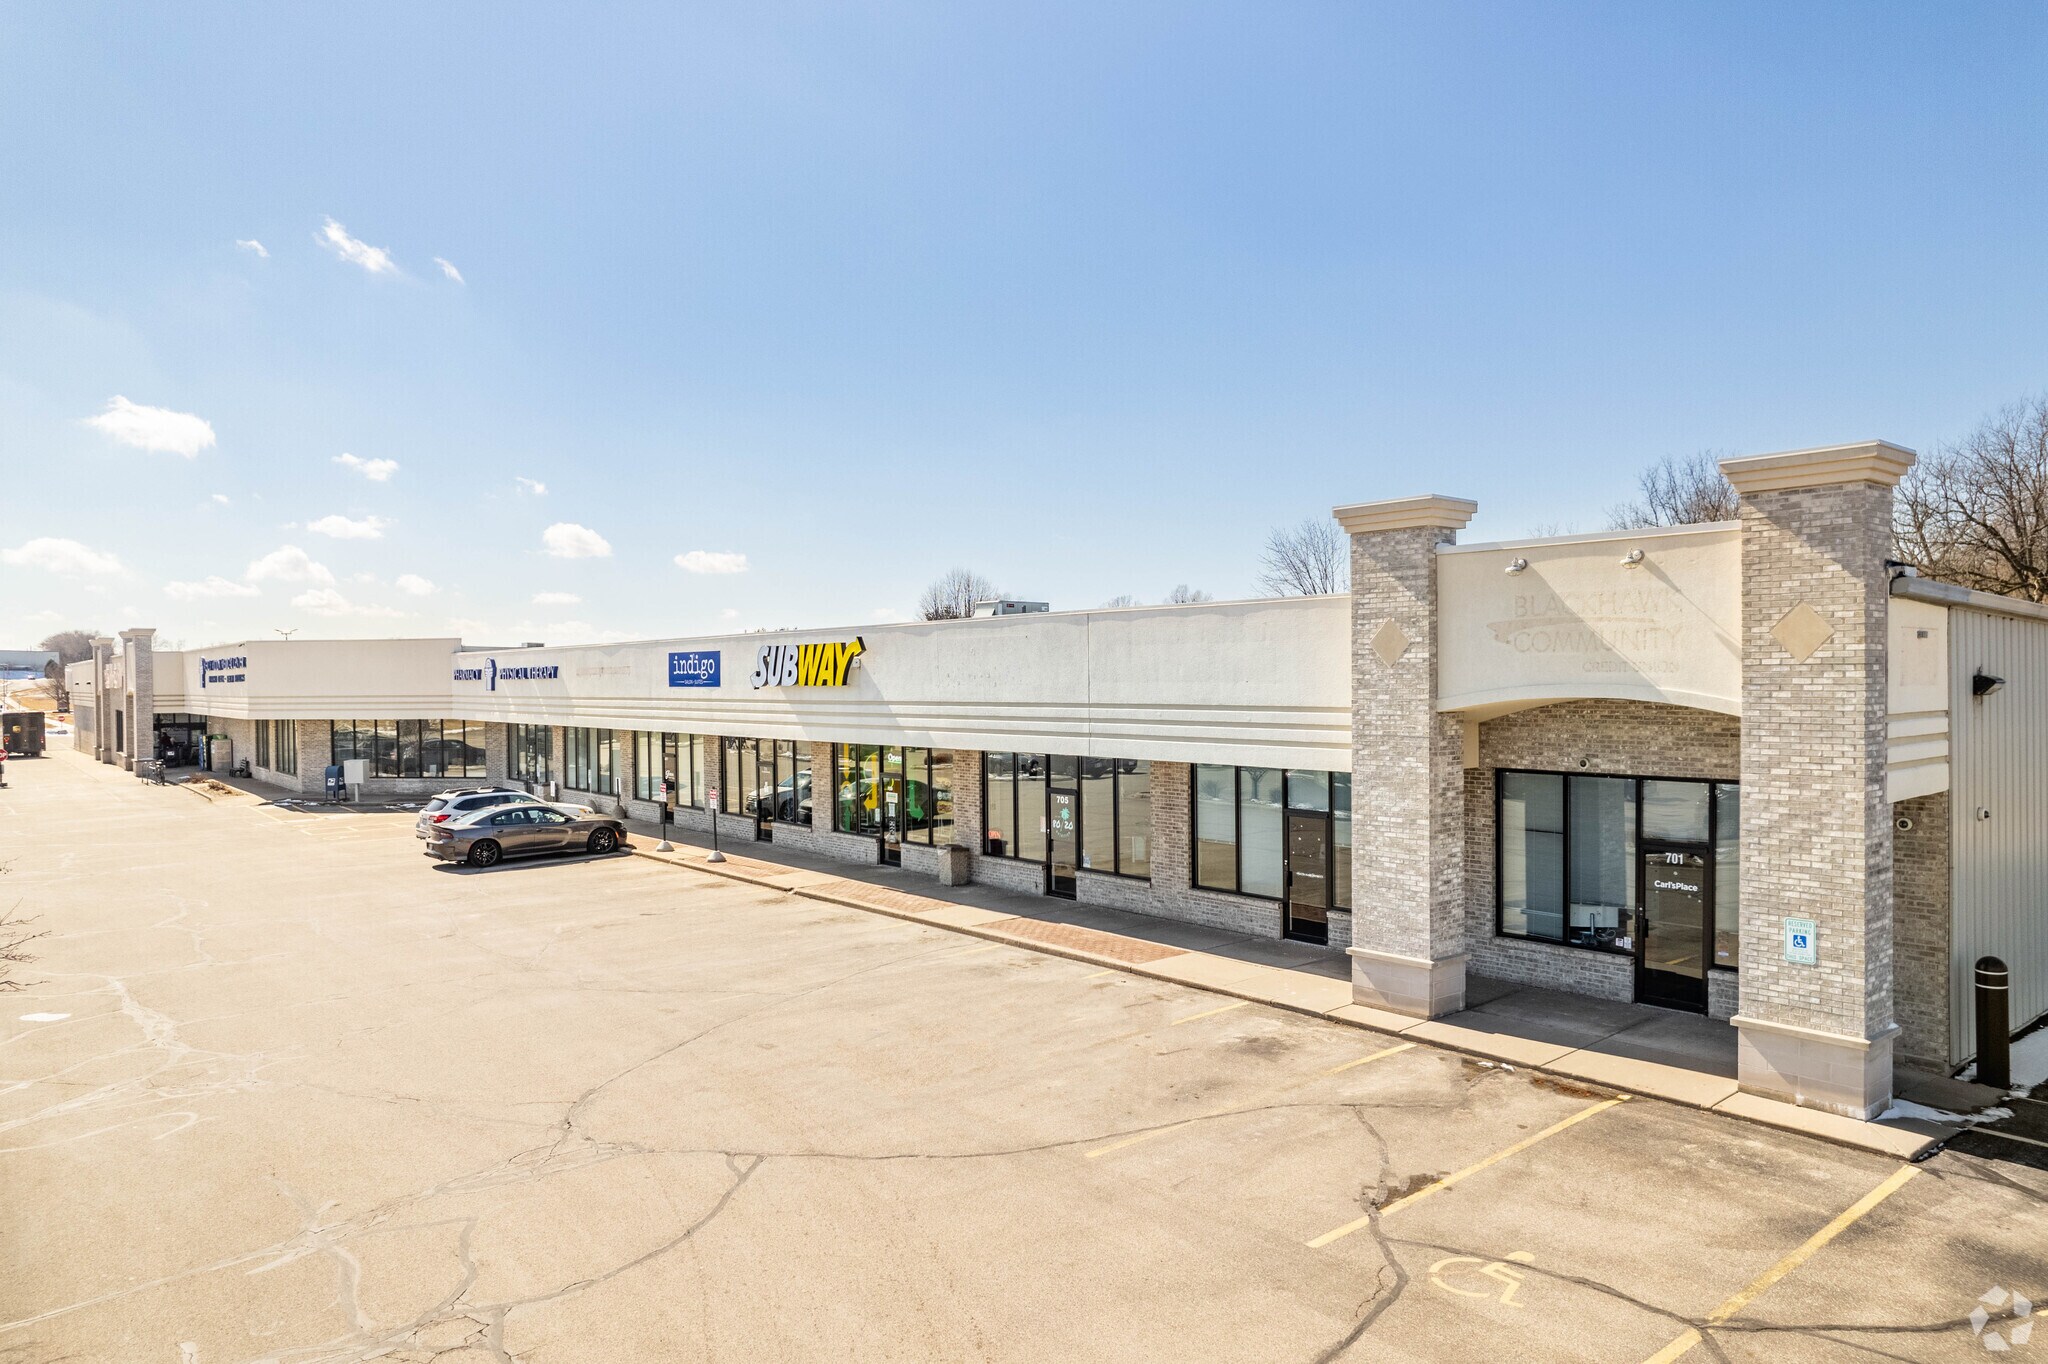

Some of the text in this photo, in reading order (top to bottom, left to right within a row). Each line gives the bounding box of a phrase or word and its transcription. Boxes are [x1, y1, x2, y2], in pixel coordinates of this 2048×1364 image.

[1513, 623, 1683, 652] COMMUNITY
[673, 653, 715, 680] indigo
[750, 636, 866, 690] SUBWAY
[1582, 661, 1628, 672] CREDIT
[500, 667, 529, 680] PHYSICAL
[530, 666, 559, 679] THERAPY
[1056, 795, 1069, 804] 705
[1665, 852, 1684, 865] 701
[1654, 880, 1698, 891] Carl'sPlace
